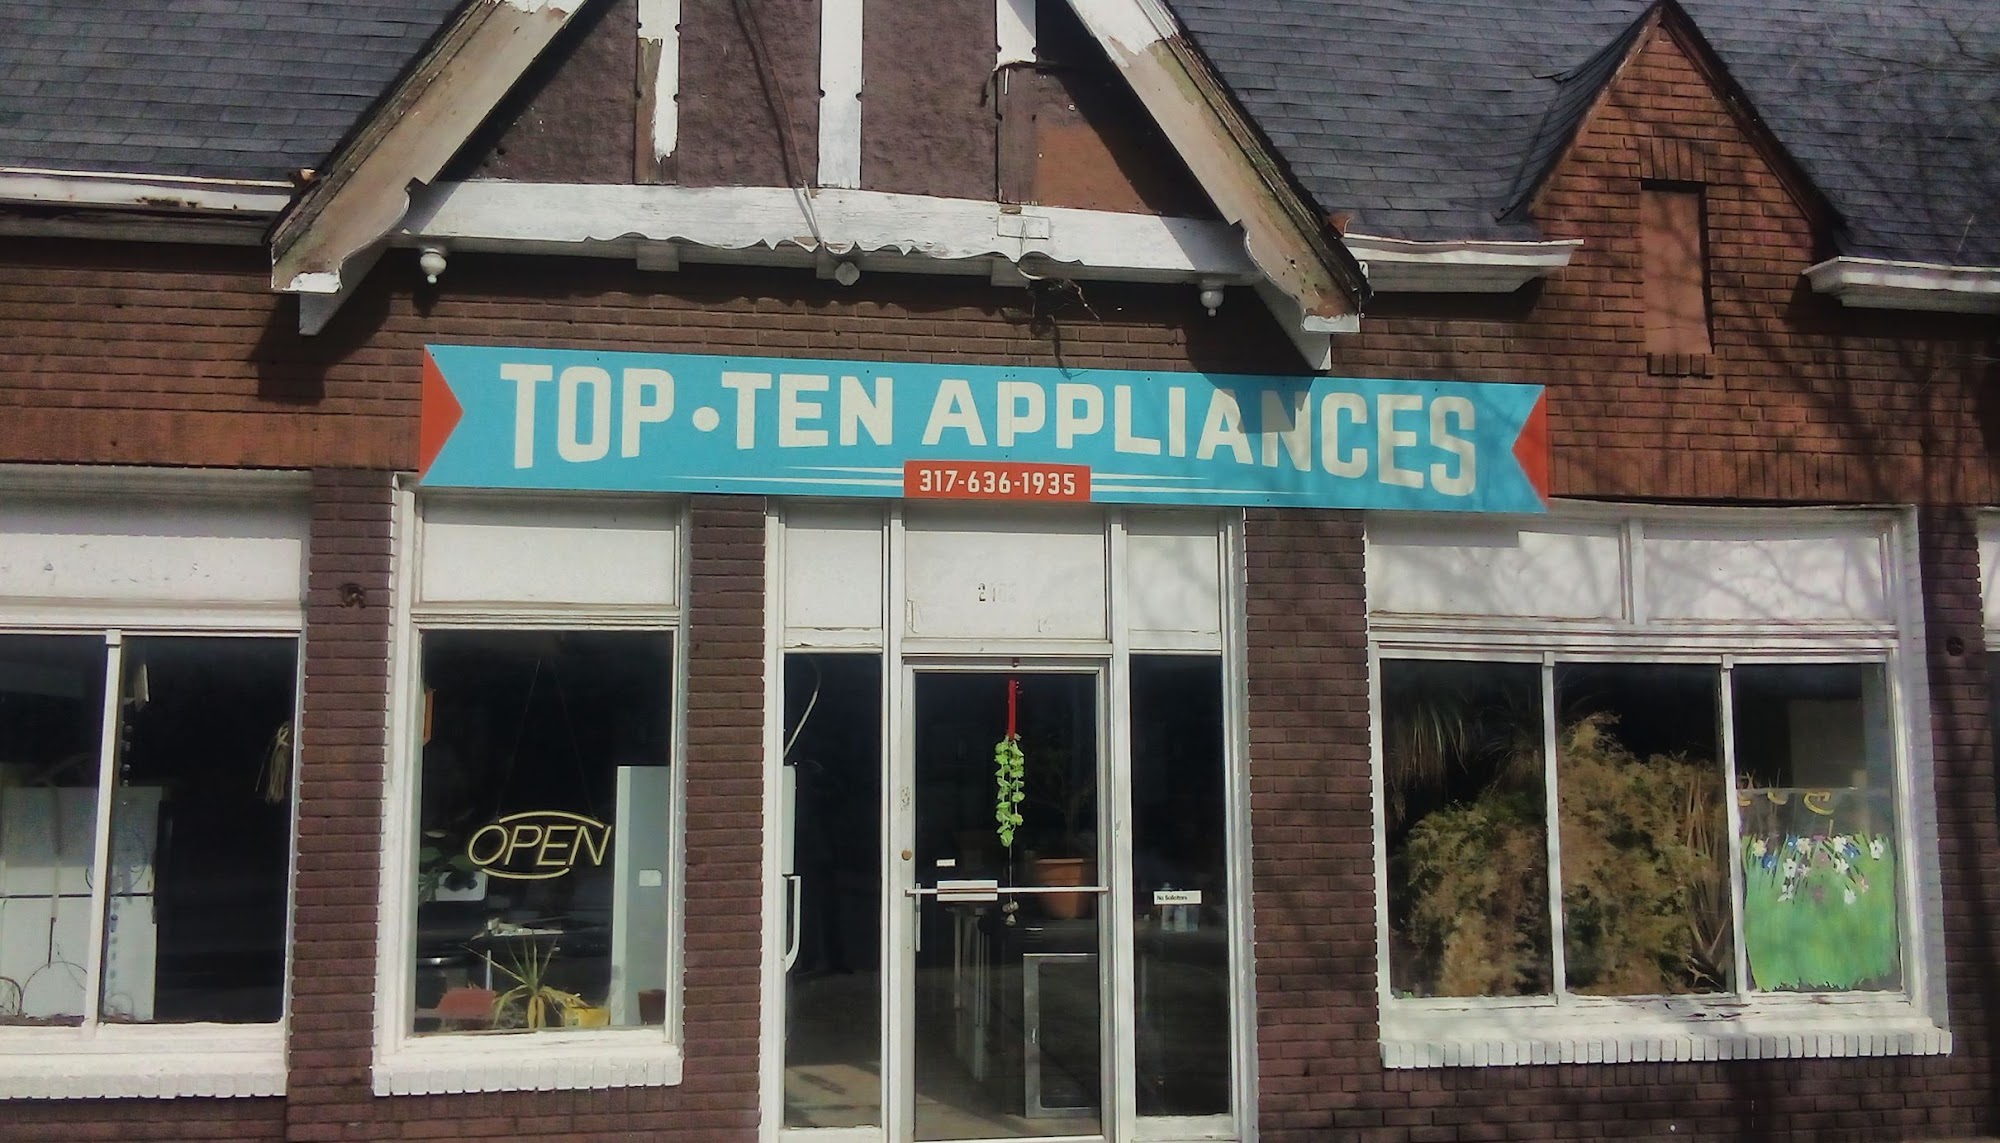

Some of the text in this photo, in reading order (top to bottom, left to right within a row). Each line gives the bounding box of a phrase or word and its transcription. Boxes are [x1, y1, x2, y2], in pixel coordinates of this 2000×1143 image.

[500, 363, 674, 469] TOP
[921, 379, 1476, 497] APPLIANCES
[919, 469, 1076, 495] 317-636-1935
[467, 824, 612, 867] OPEN
